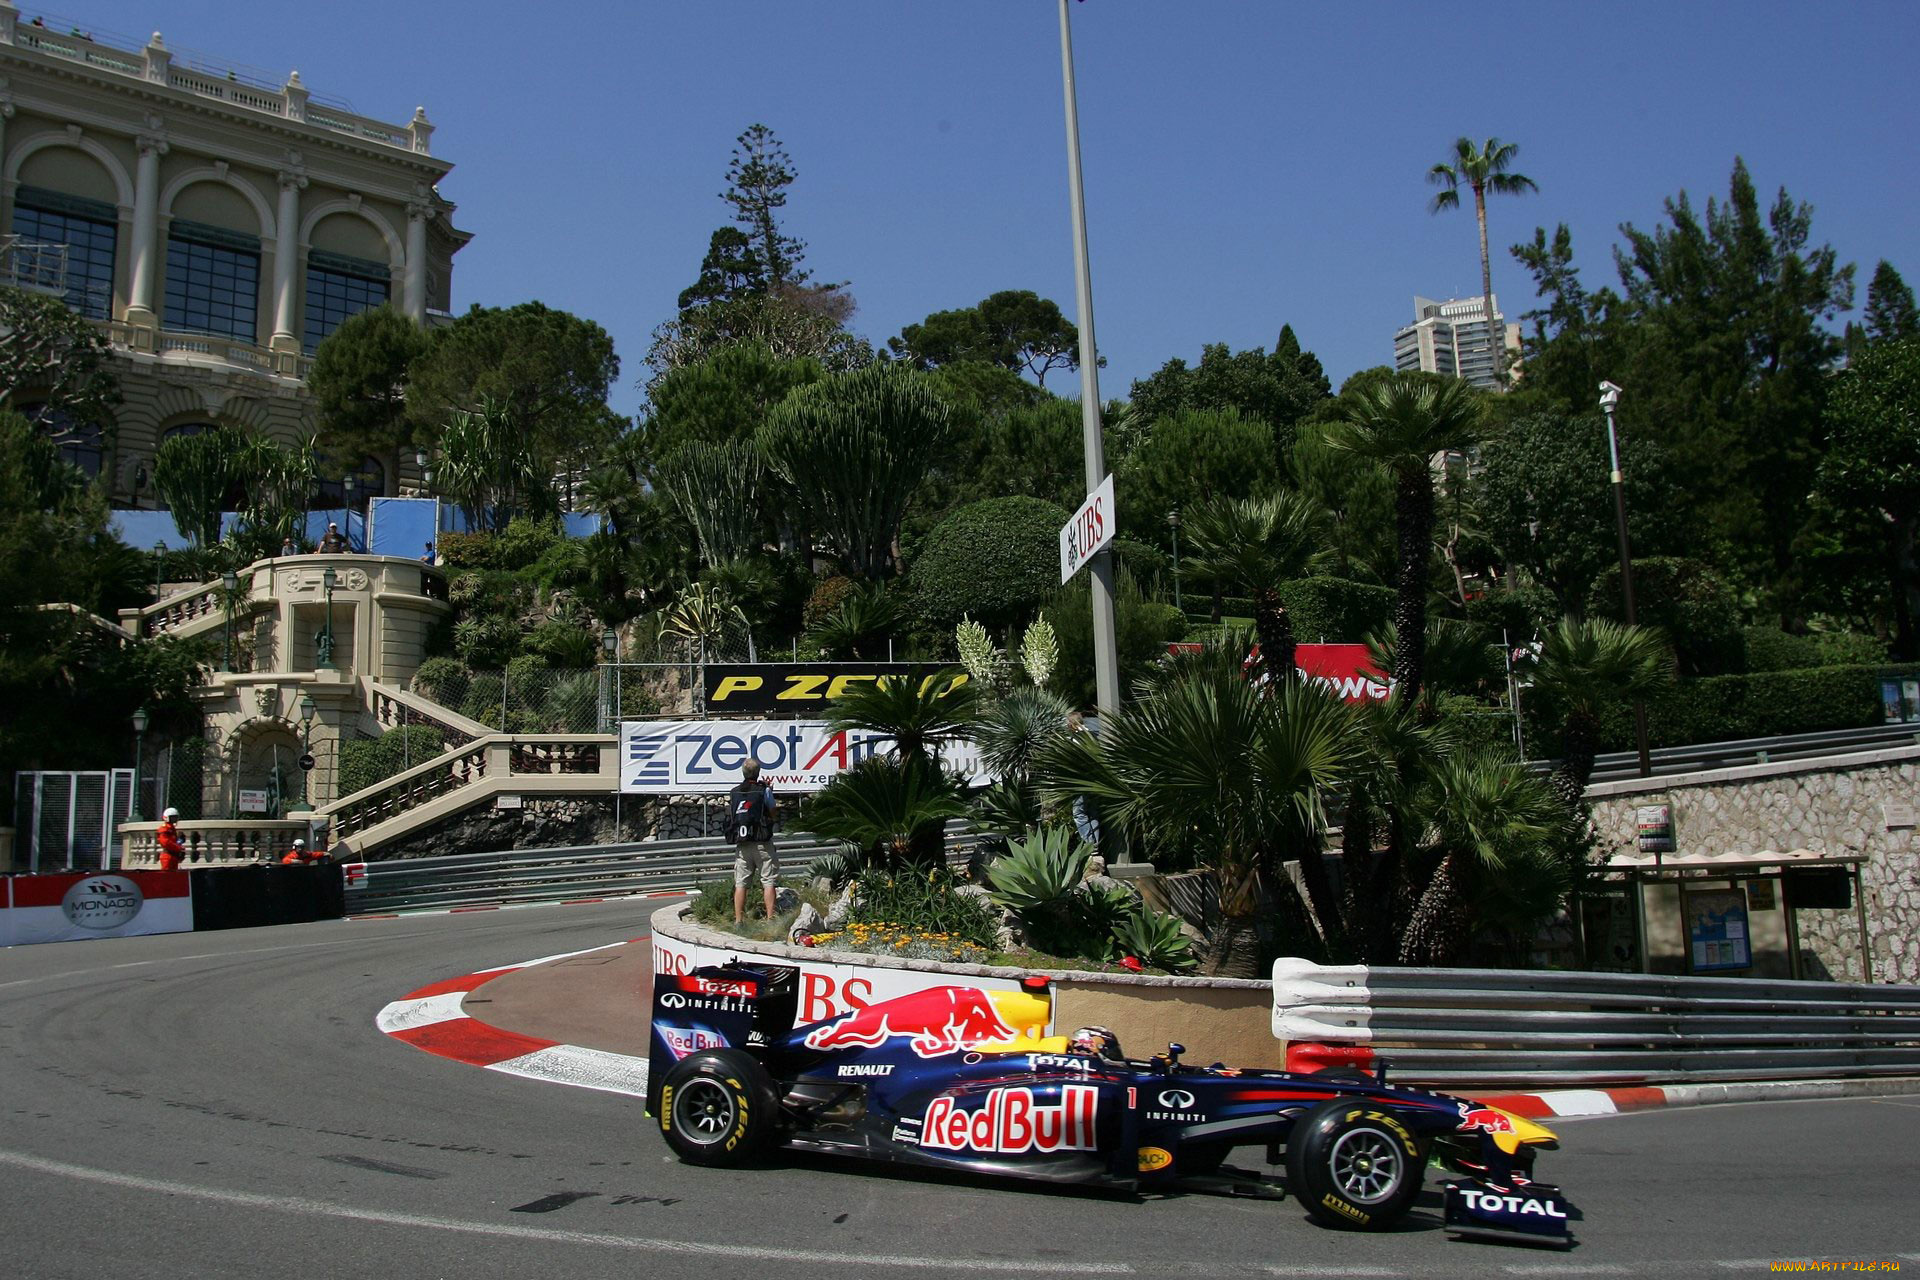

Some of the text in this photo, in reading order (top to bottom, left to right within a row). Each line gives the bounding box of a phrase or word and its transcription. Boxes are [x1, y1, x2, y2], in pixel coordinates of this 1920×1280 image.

[1077, 495, 1104, 558] UBS
[711, 676, 764, 701] P
[71, 898, 136, 911] MONACO
[695, 978, 753, 996] TOTAL
[687, 998, 752, 1013] INFINITI
[666, 1030, 693, 1049] Red
[837, 1064, 896, 1077] RENAULT
[1025, 1053, 1097, 1072] TOTAL
[1127, 1086, 1137, 1110] 1
[922, 1085, 1098, 1151] Red Bull
[1146, 1111, 1206, 1122] INFINITI
[1345, 1109, 1364, 1123] P
[1364, 1110, 1418, 1157] ZERO
[1322, 1192, 1372, 1225] PIRELLI
[1459, 1189, 1567, 1218] TOTAL
